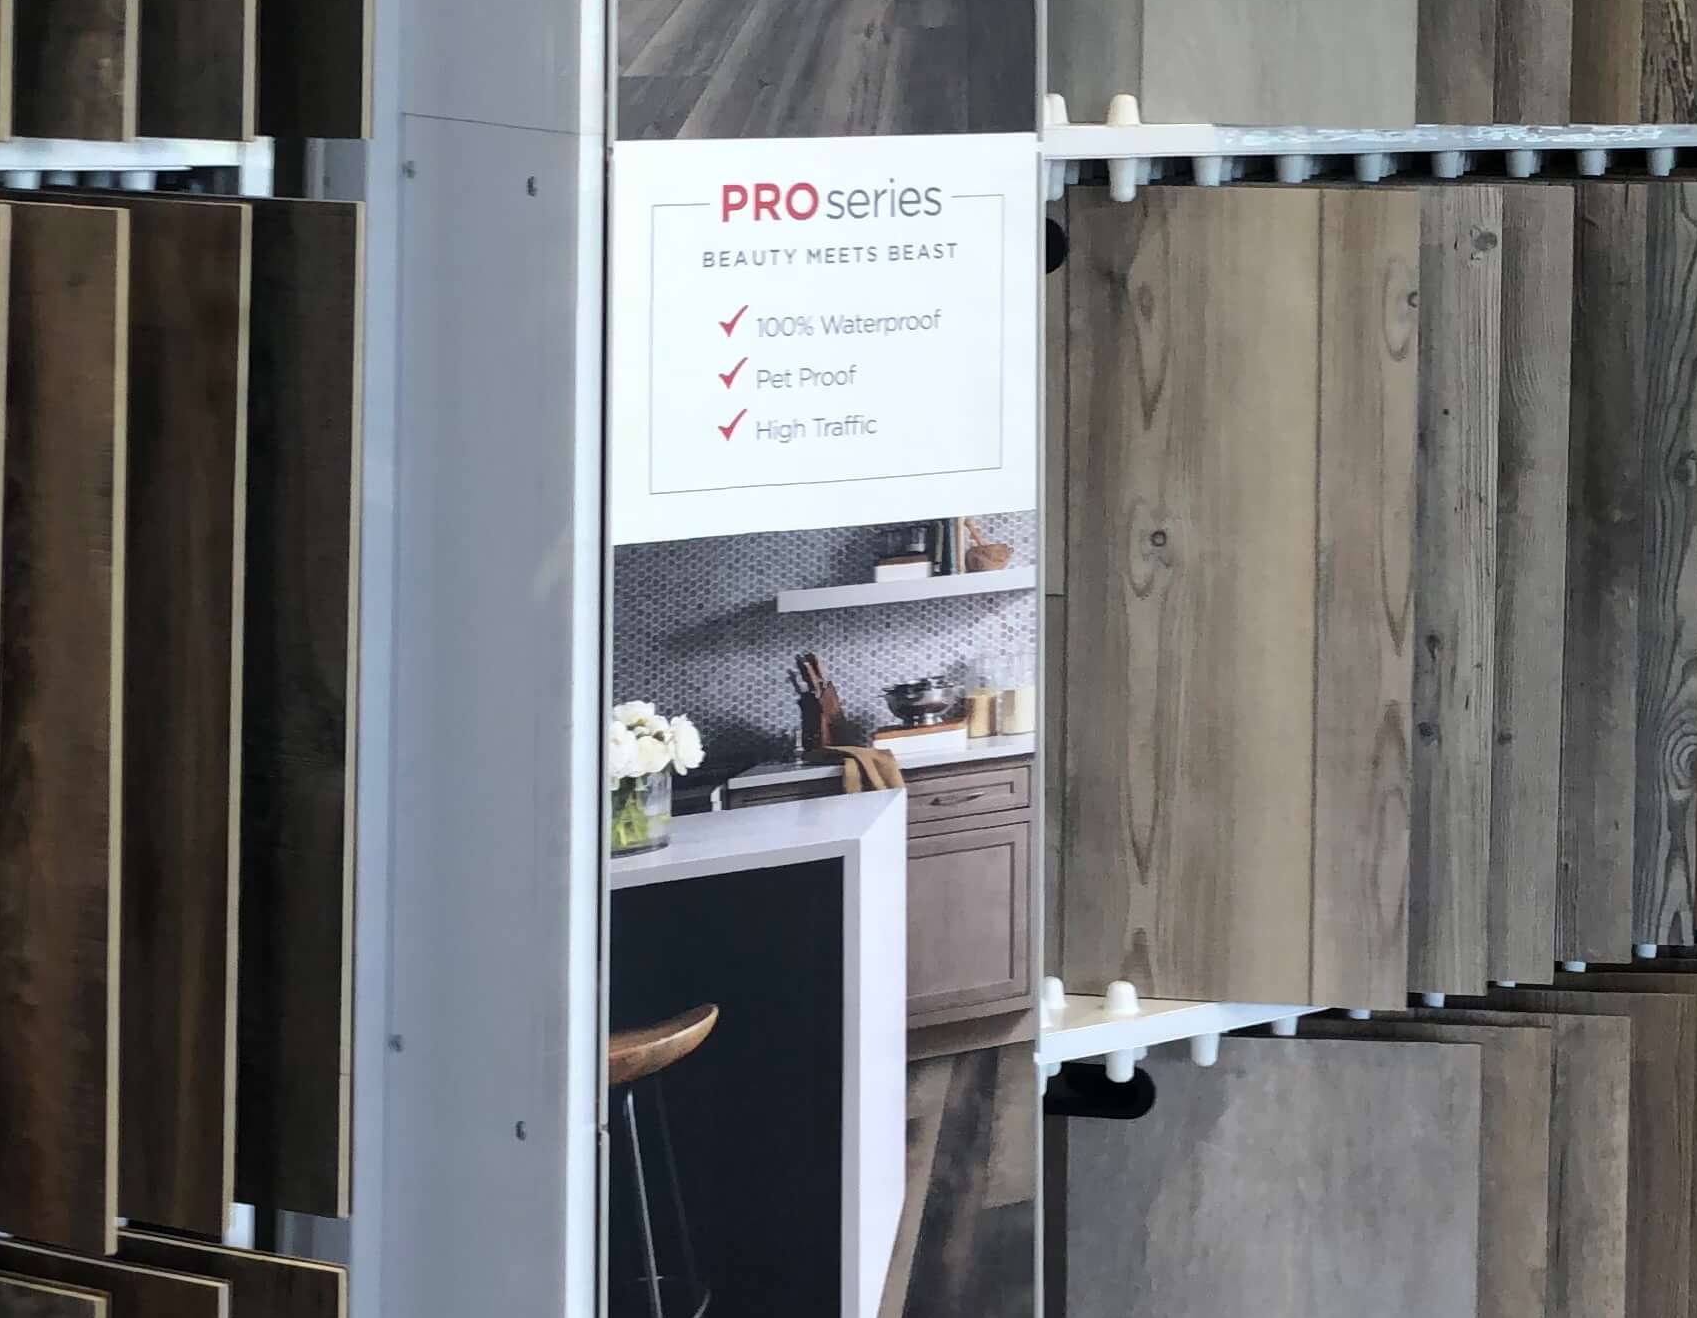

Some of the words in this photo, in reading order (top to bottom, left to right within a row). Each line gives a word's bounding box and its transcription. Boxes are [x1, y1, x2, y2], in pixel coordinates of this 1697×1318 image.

[721, 182, 819, 222] PRO
[826, 178, 942, 219] series
[703, 249, 796, 268] BEAUTY
[807, 247, 878, 264] MEETS
[889, 243, 957, 261] BEAST
[757, 316, 814, 337] 100%
[821, 309, 941, 338] Waterproof
[757, 370, 792, 389] Pet
[799, 365, 856, 387] Proof
[757, 419, 805, 444] High
[812, 415, 878, 438] Traffic
